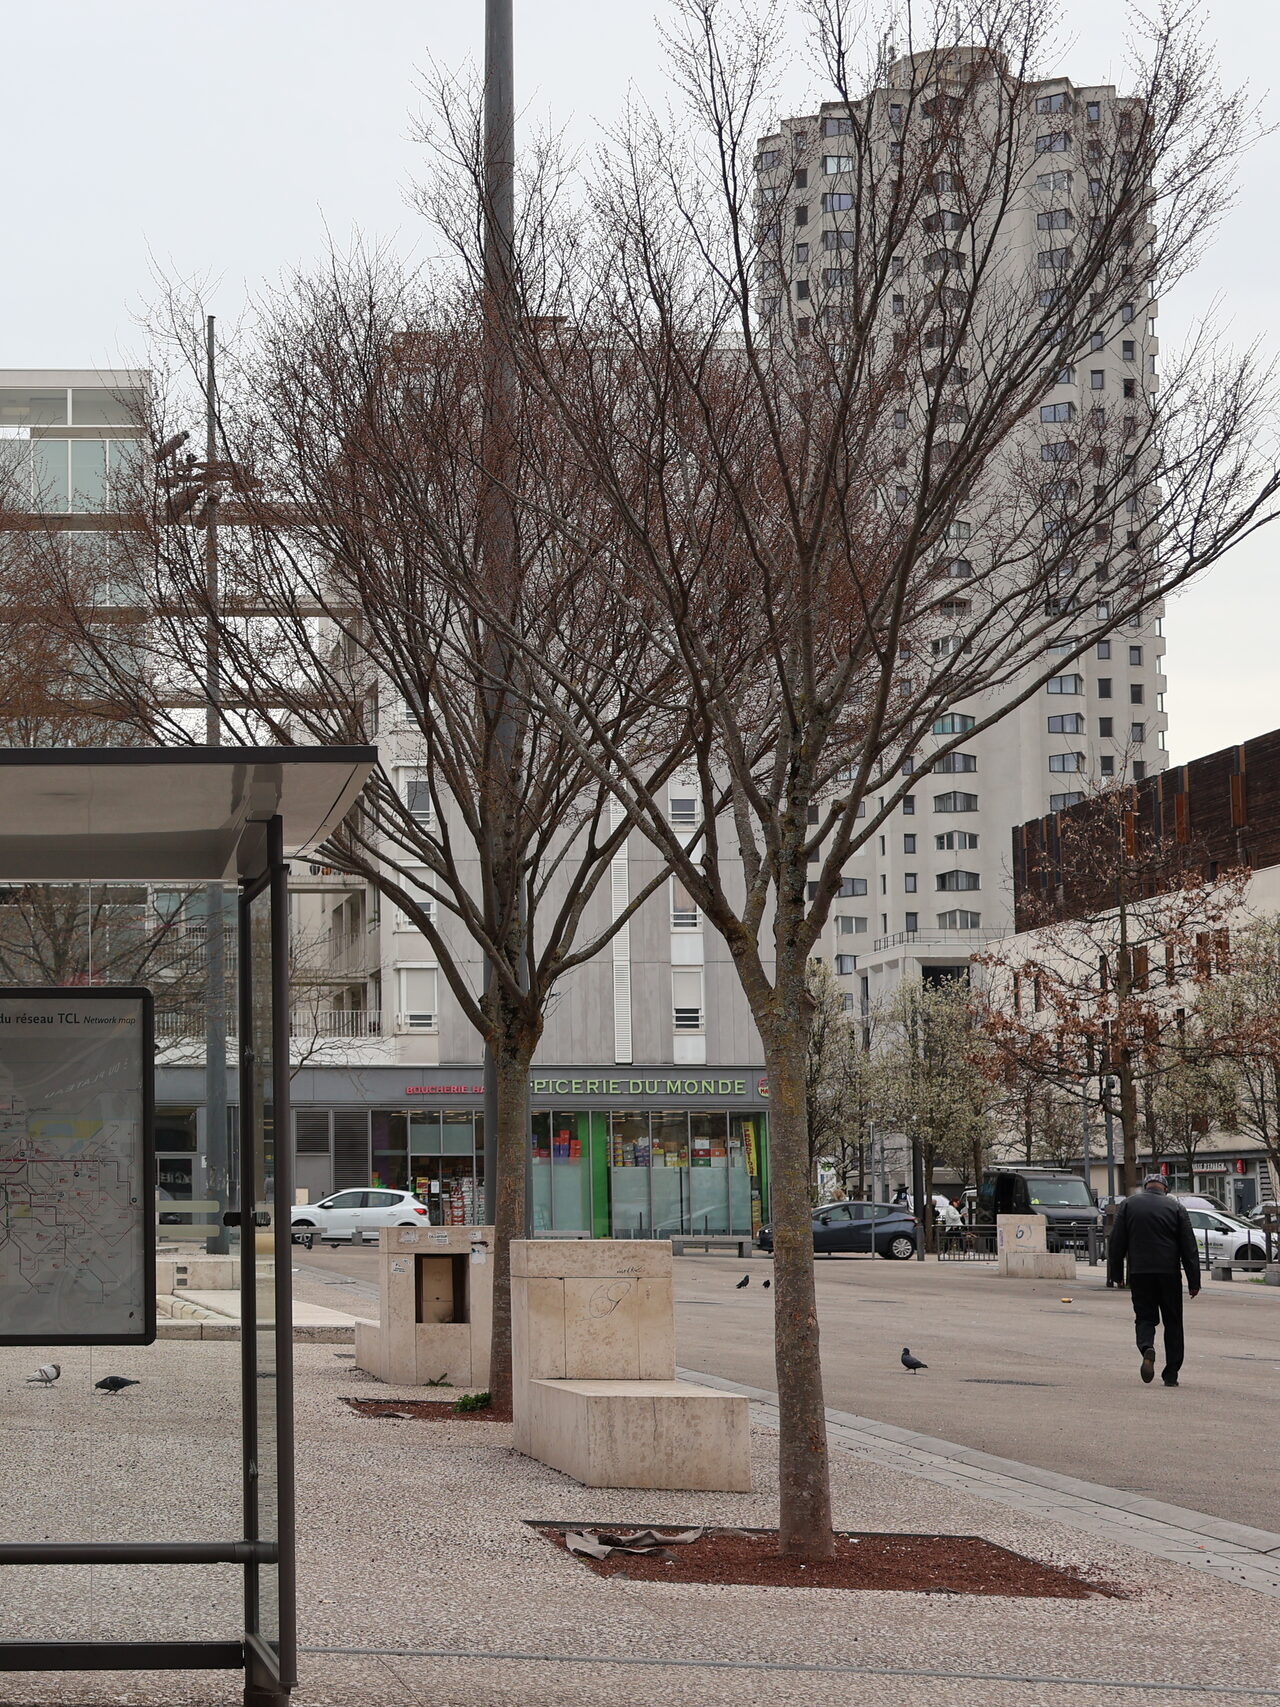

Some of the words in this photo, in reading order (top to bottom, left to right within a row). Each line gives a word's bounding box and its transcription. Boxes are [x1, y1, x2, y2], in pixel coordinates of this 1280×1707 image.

[16, 1012, 54, 1024] réseau
[57, 1013, 80, 1024] TCL
[83, 1015, 117, 1024] Network
[118, 1017, 136, 1026] map
[405, 1086, 468, 1095] BOUCHERIE
[530, 1079, 622, 1094] PICERIE
[629, 1079, 661, 1094] DU
[666, 1079, 746, 1095] MONDE
